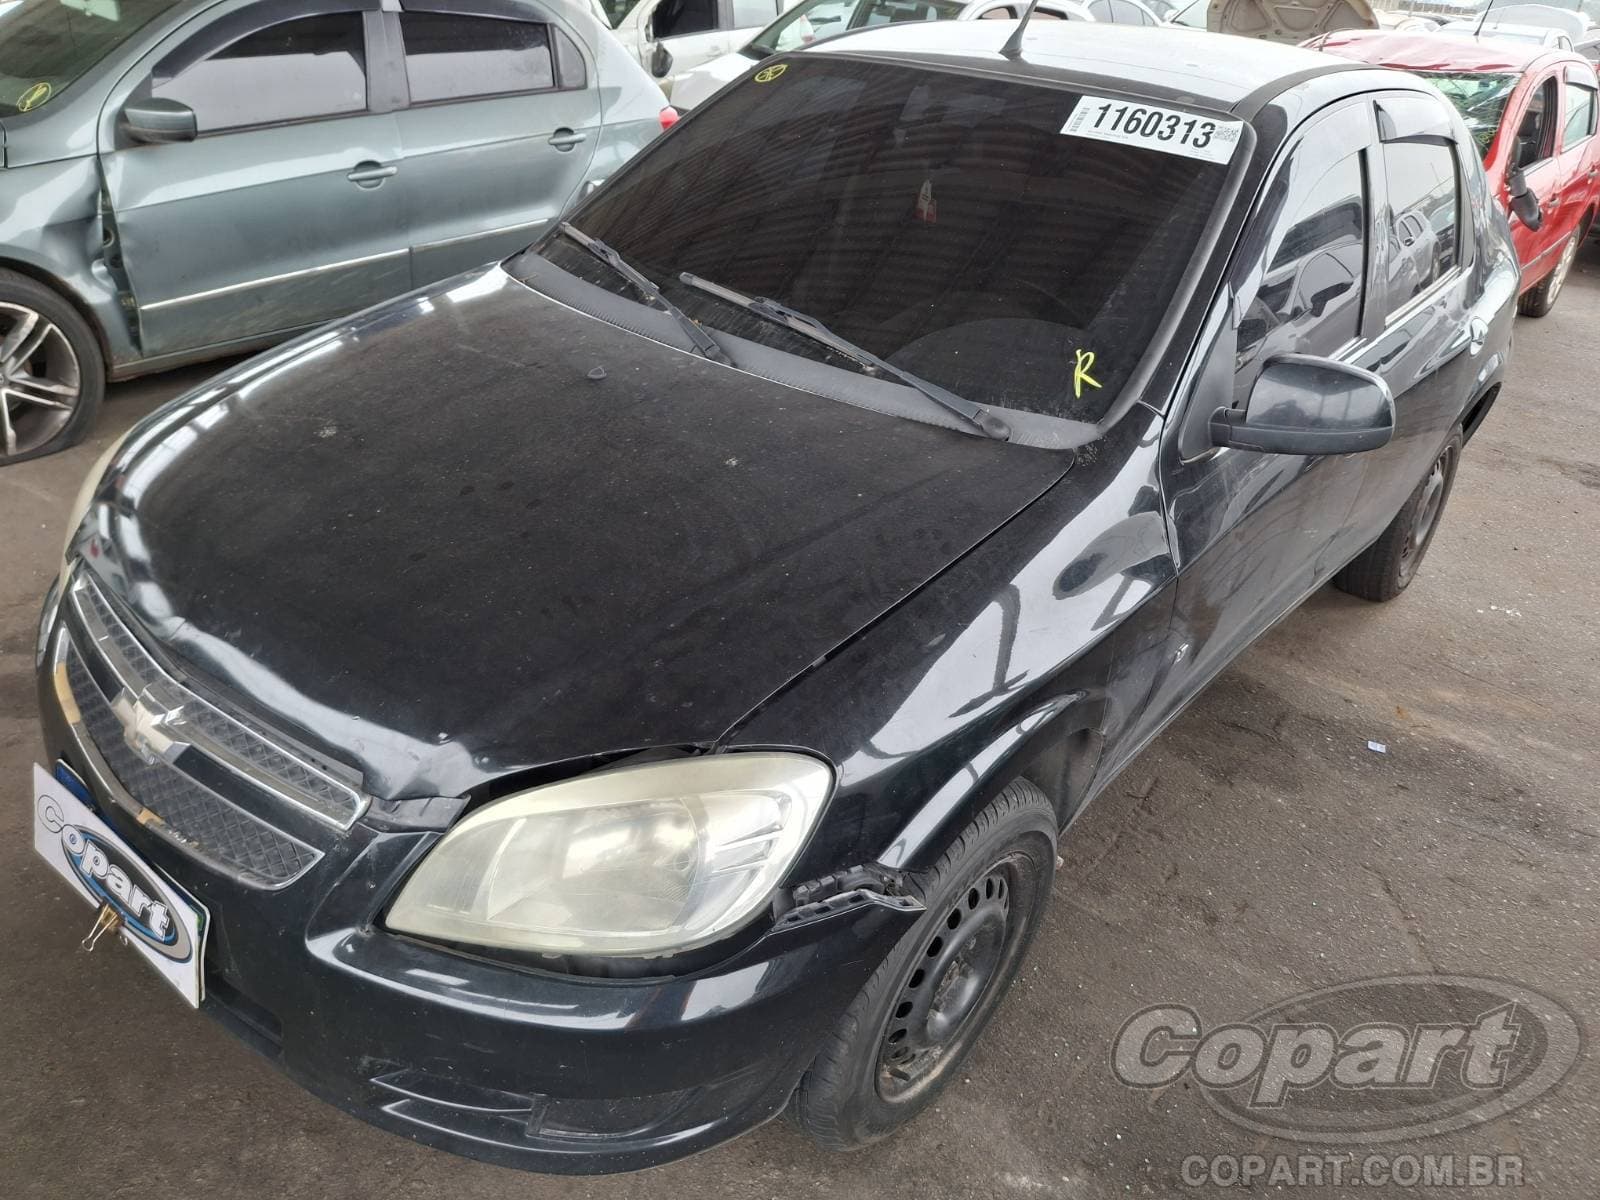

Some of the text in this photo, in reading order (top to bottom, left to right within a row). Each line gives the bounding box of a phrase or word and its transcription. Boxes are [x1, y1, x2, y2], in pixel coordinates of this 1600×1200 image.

[1093, 103, 1217, 149] 1160313
[1074, 348, 1103, 399] R
[37, 794, 170, 941] Copart
